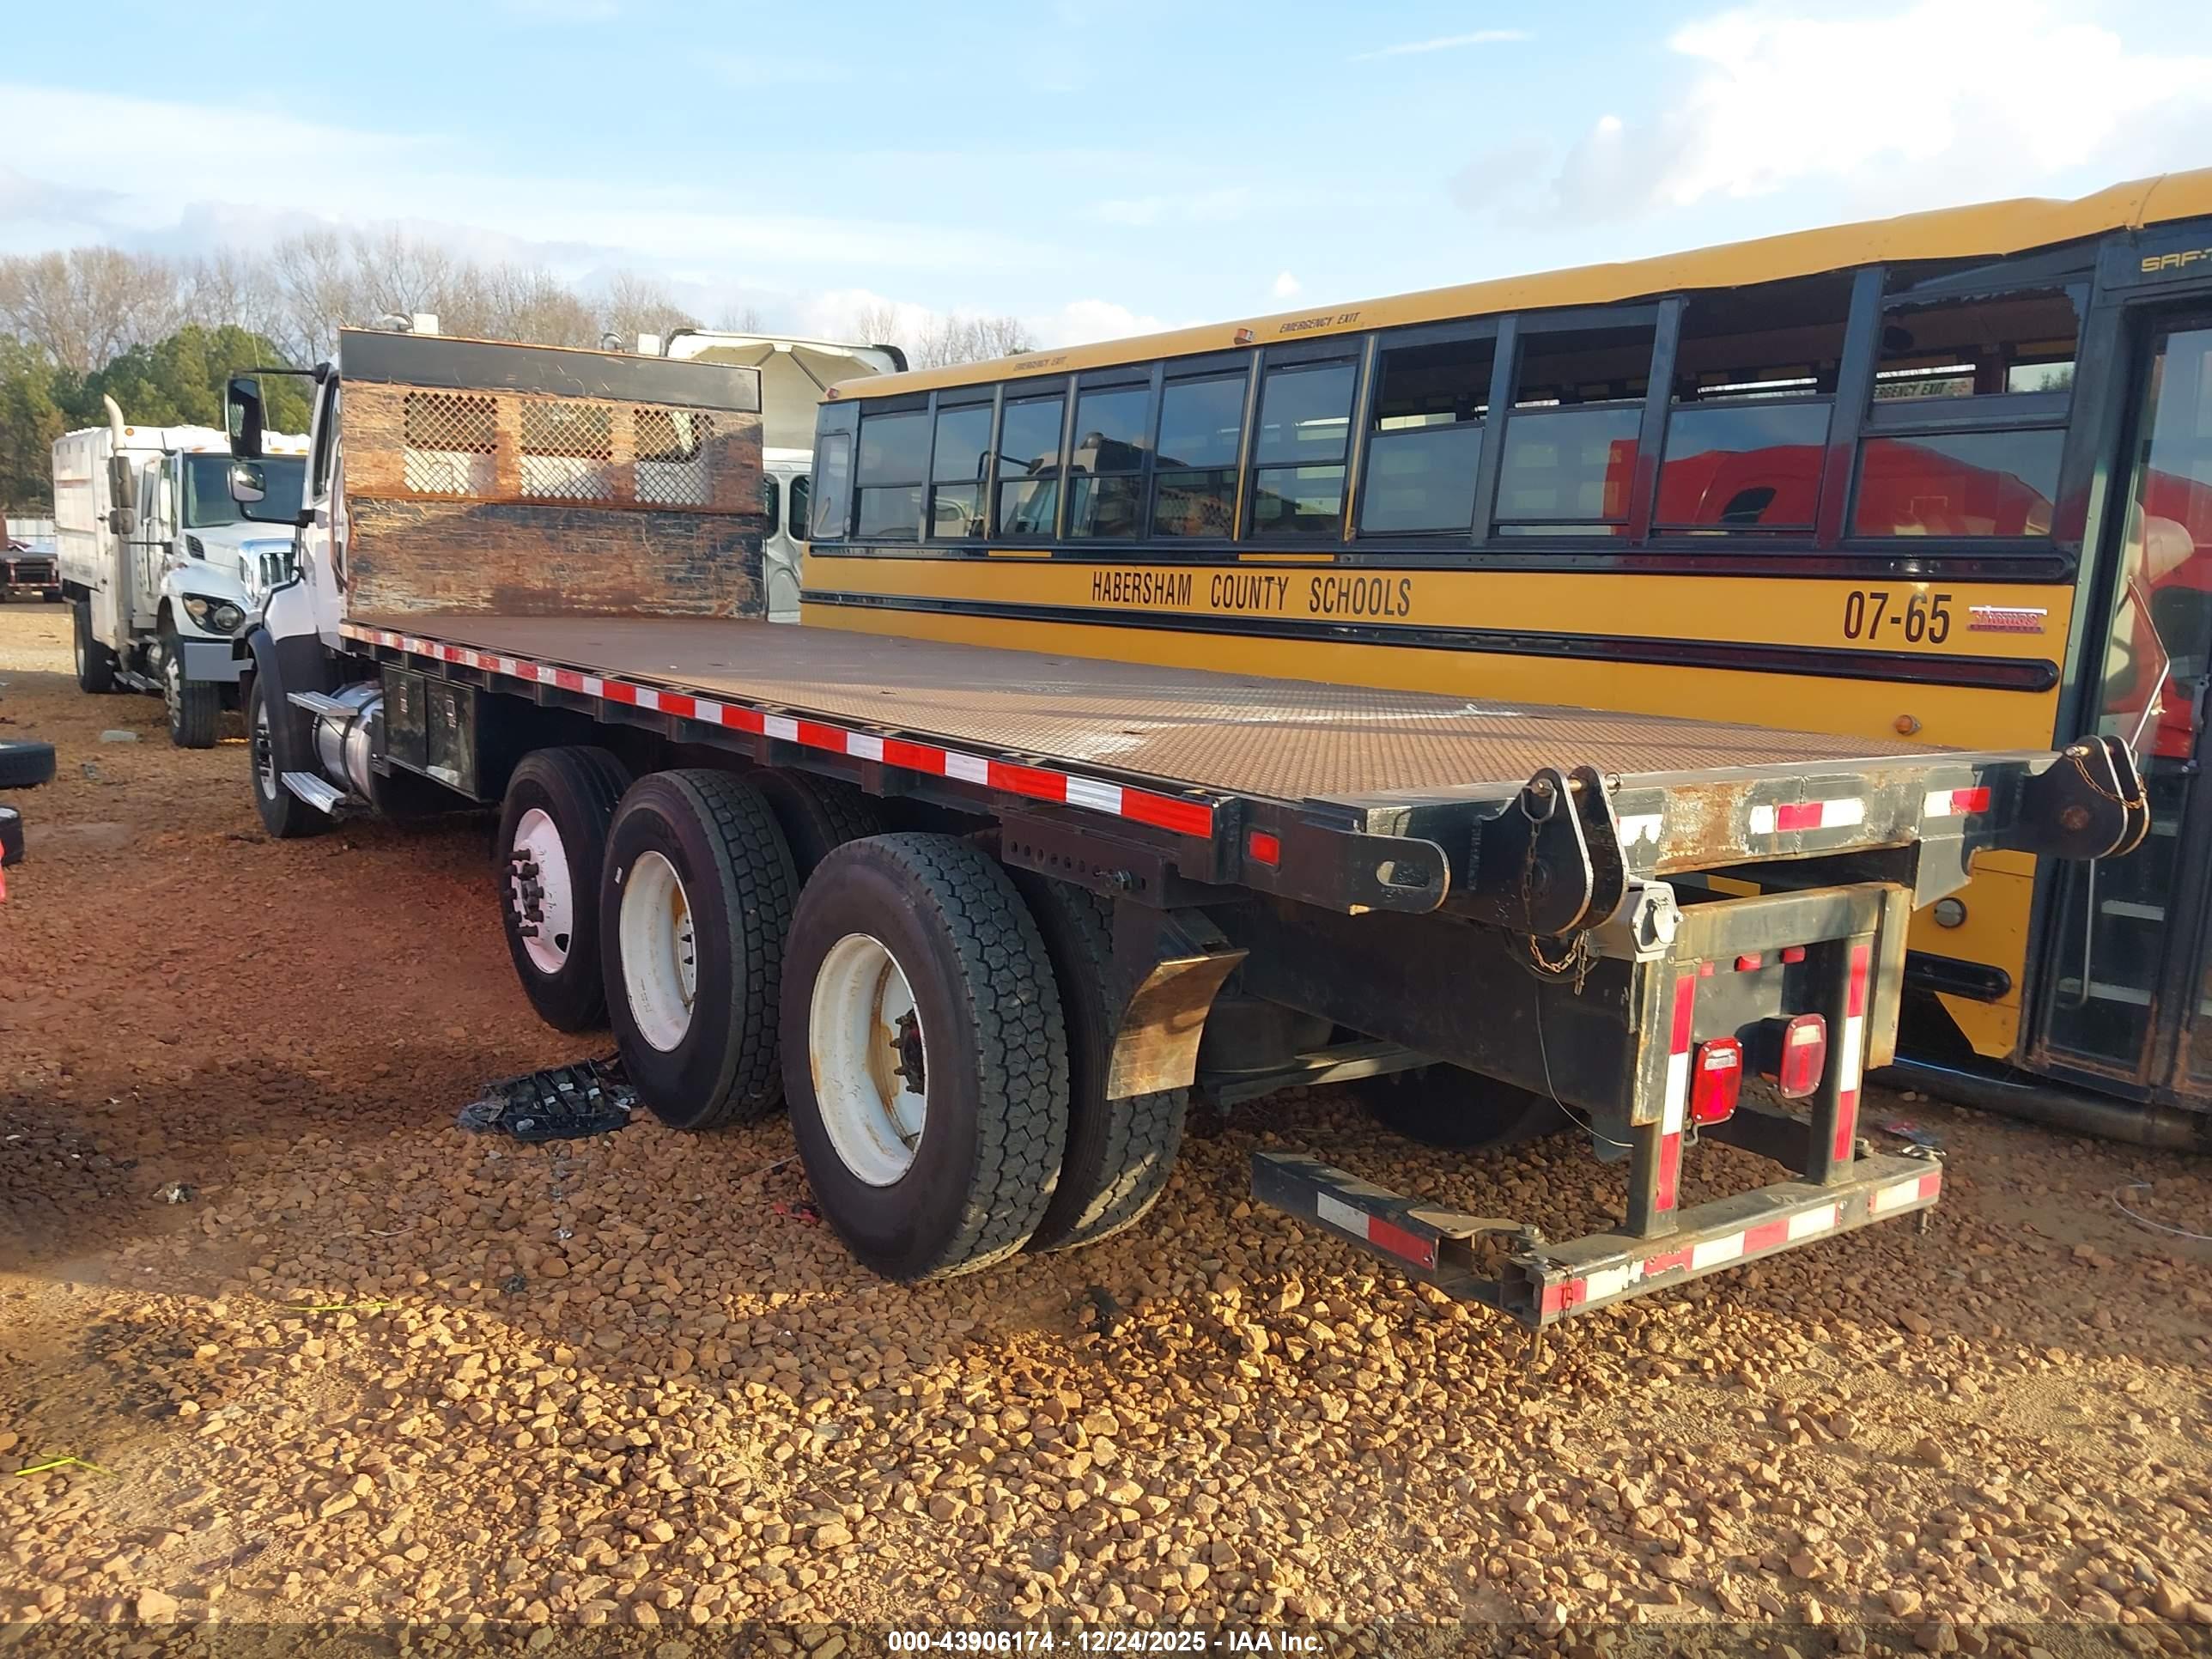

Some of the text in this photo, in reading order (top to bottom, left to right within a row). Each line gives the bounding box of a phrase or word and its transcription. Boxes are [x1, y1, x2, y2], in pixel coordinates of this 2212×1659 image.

[1279, 312, 1360, 333] EMERGENCY EXIT
[1921, 382, 1948, 396] EXIT
[1091, 571, 1412, 617] HABERSHAM COUNTY SCHOOLS
[1844, 590, 1952, 644] 07-65
